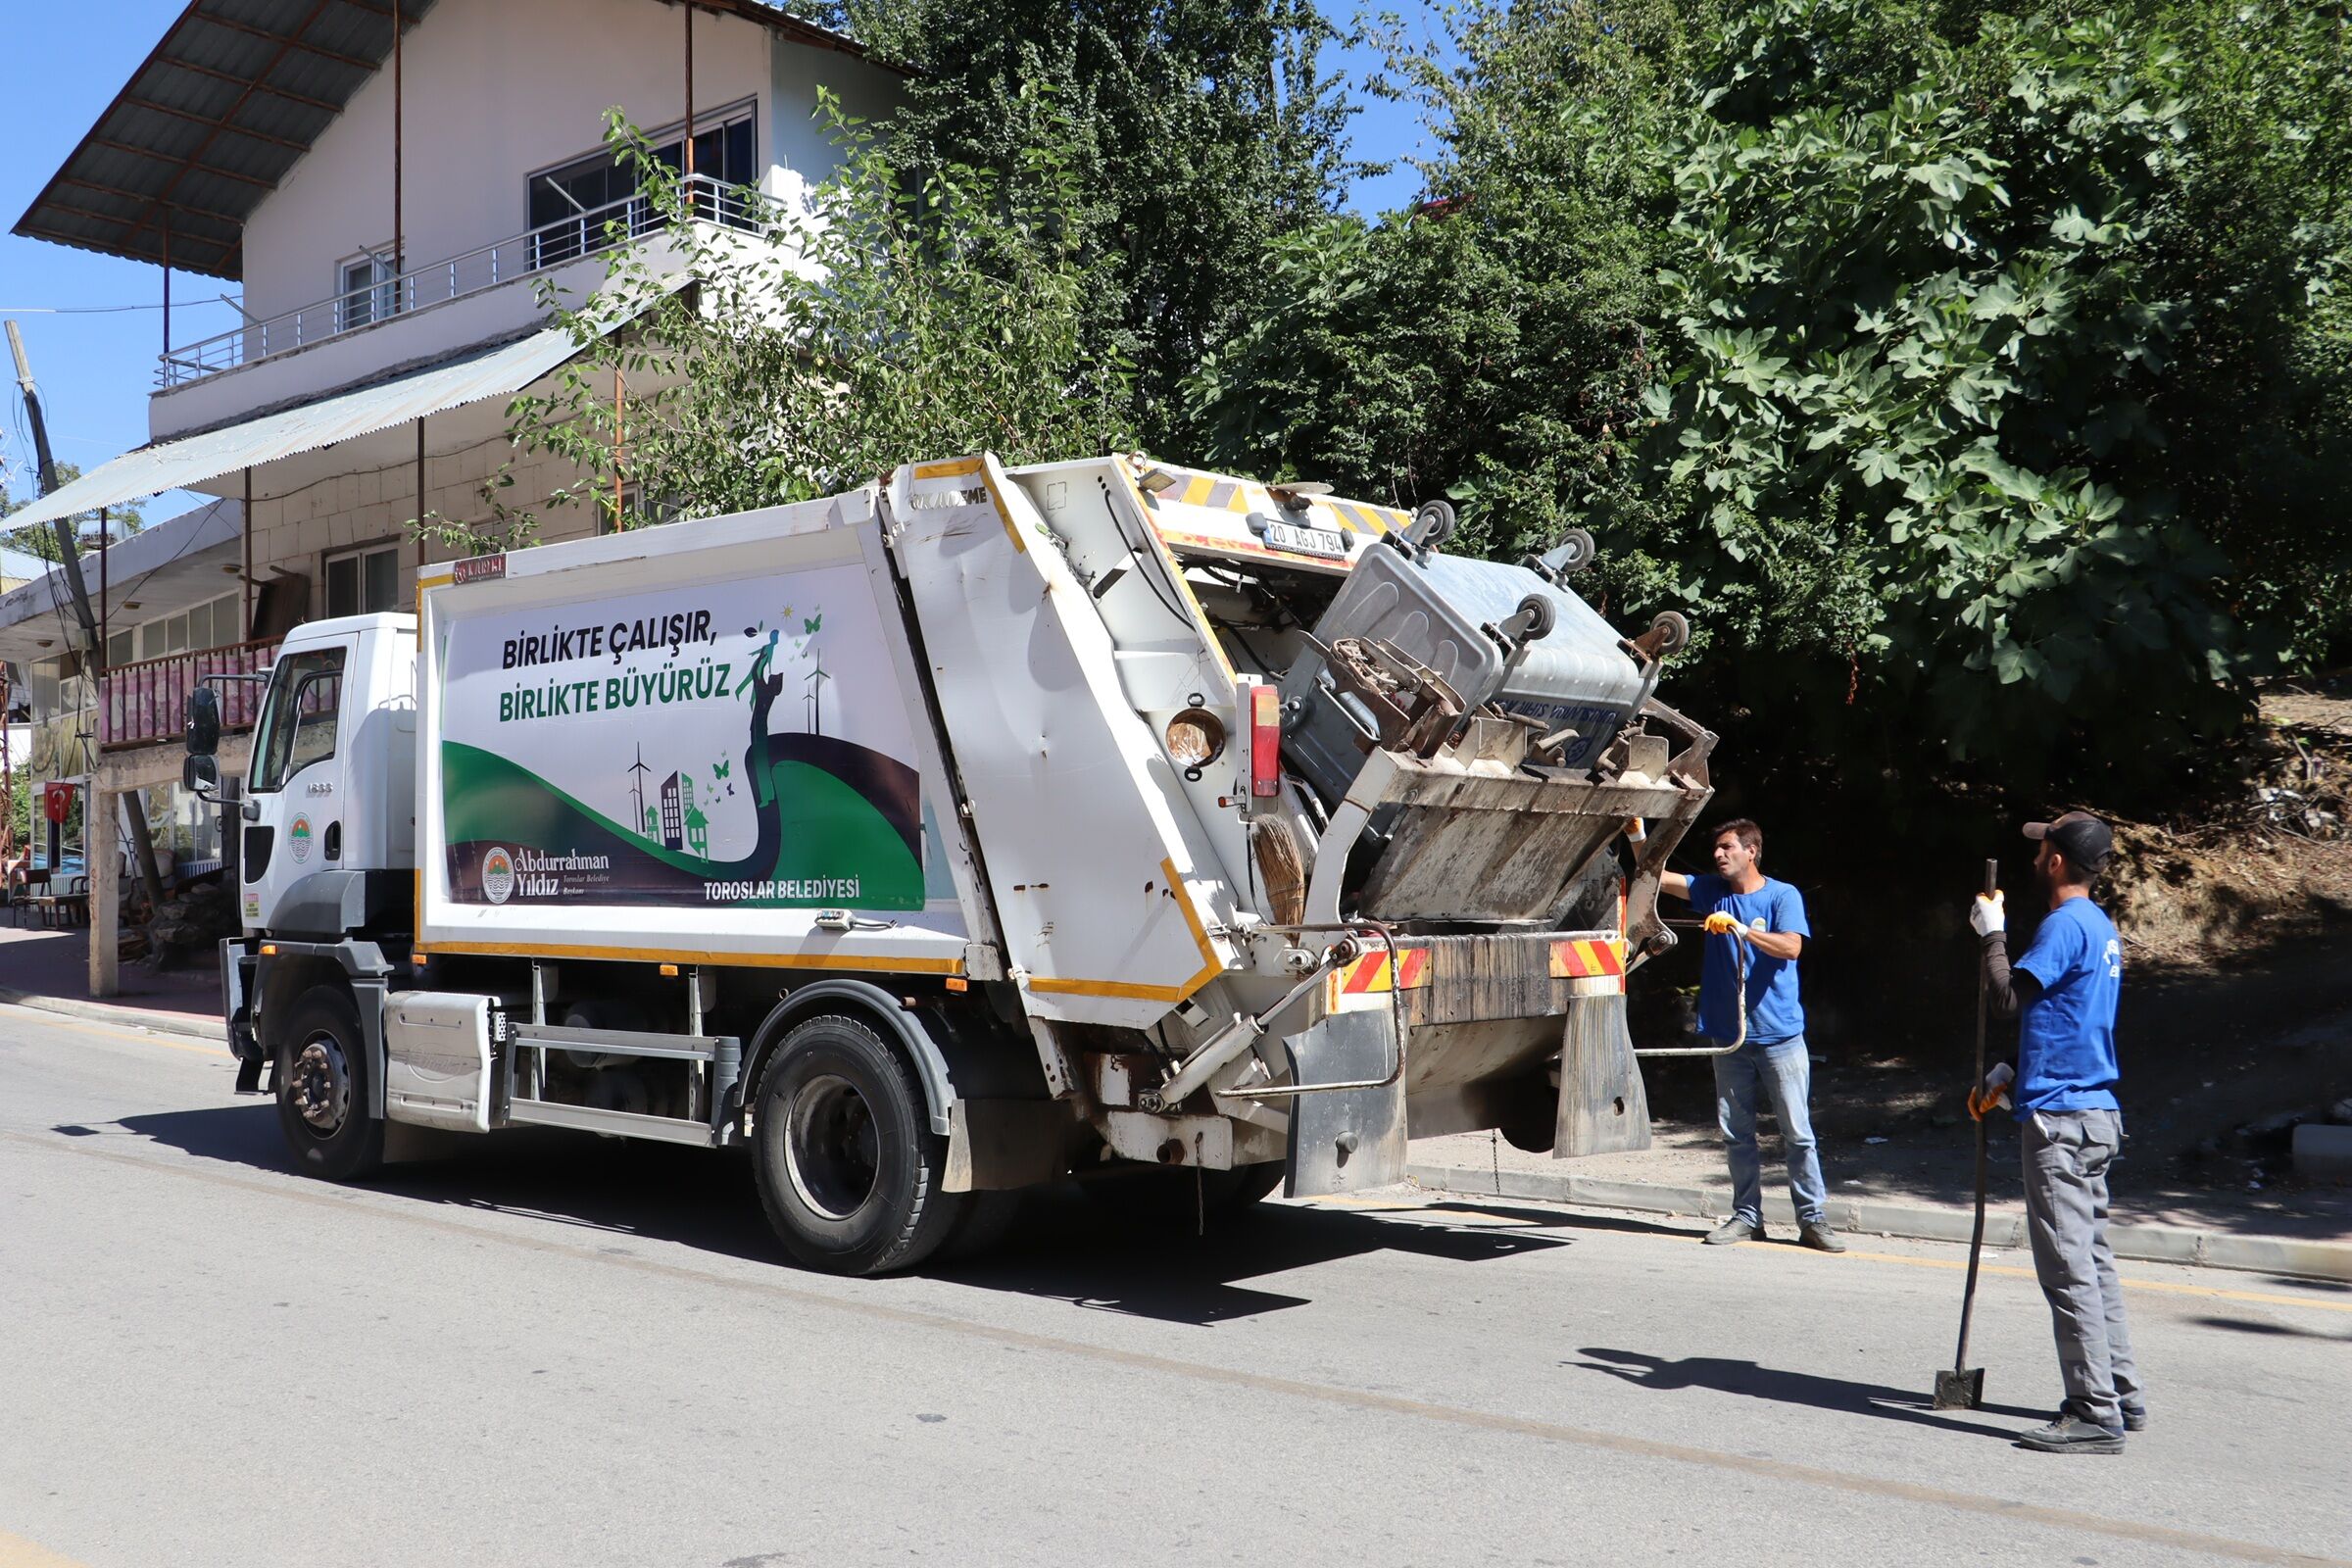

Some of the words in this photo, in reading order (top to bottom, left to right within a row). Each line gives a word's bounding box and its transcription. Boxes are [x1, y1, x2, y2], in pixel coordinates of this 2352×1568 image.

[1270, 523, 1286, 543] 20
[1295, 528, 1316, 549] AGJ
[1318, 533, 1342, 554] 794
[502, 624, 604, 669] BİRLİKTE
[609, 610, 717, 665] ÇALIŞIR,
[499, 678, 600, 722] BİRLİKTE
[605, 657, 731, 710] BÜYÜRÜZ
[514, 848, 610, 871] Abdurrahman
[515, 873, 559, 896] Yıldız
[704, 881, 775, 900] TOROSLAR
[777, 874, 859, 899] BELEDİYESİ
